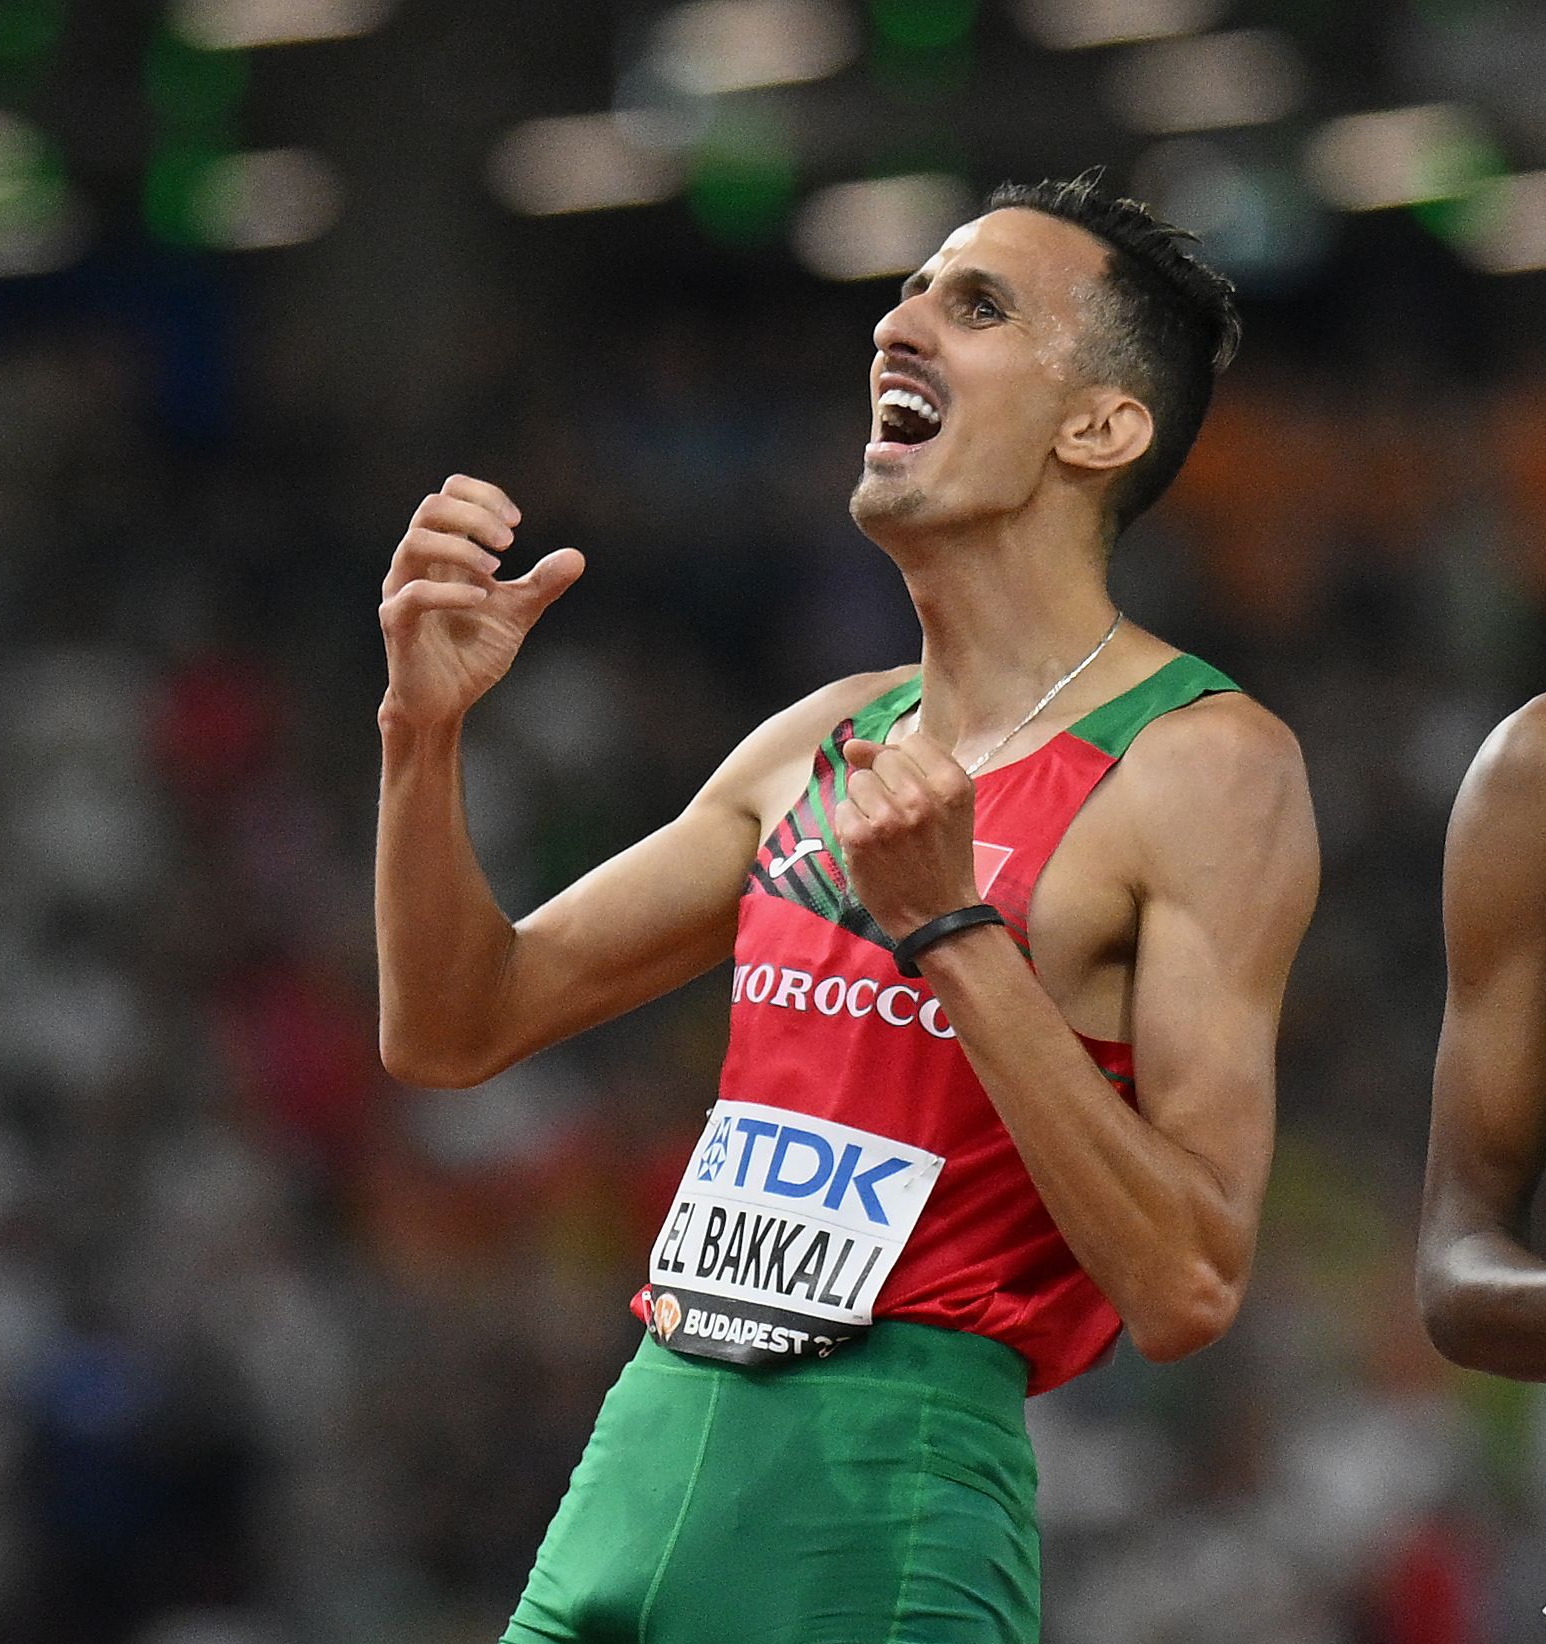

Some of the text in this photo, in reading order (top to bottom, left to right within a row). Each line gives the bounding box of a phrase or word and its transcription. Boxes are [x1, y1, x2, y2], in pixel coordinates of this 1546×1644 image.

[734, 1117, 914, 1227] TDK
[657, 1202, 884, 1311] EL BAKKALI
[683, 1308, 810, 1356] BUDAPEST
